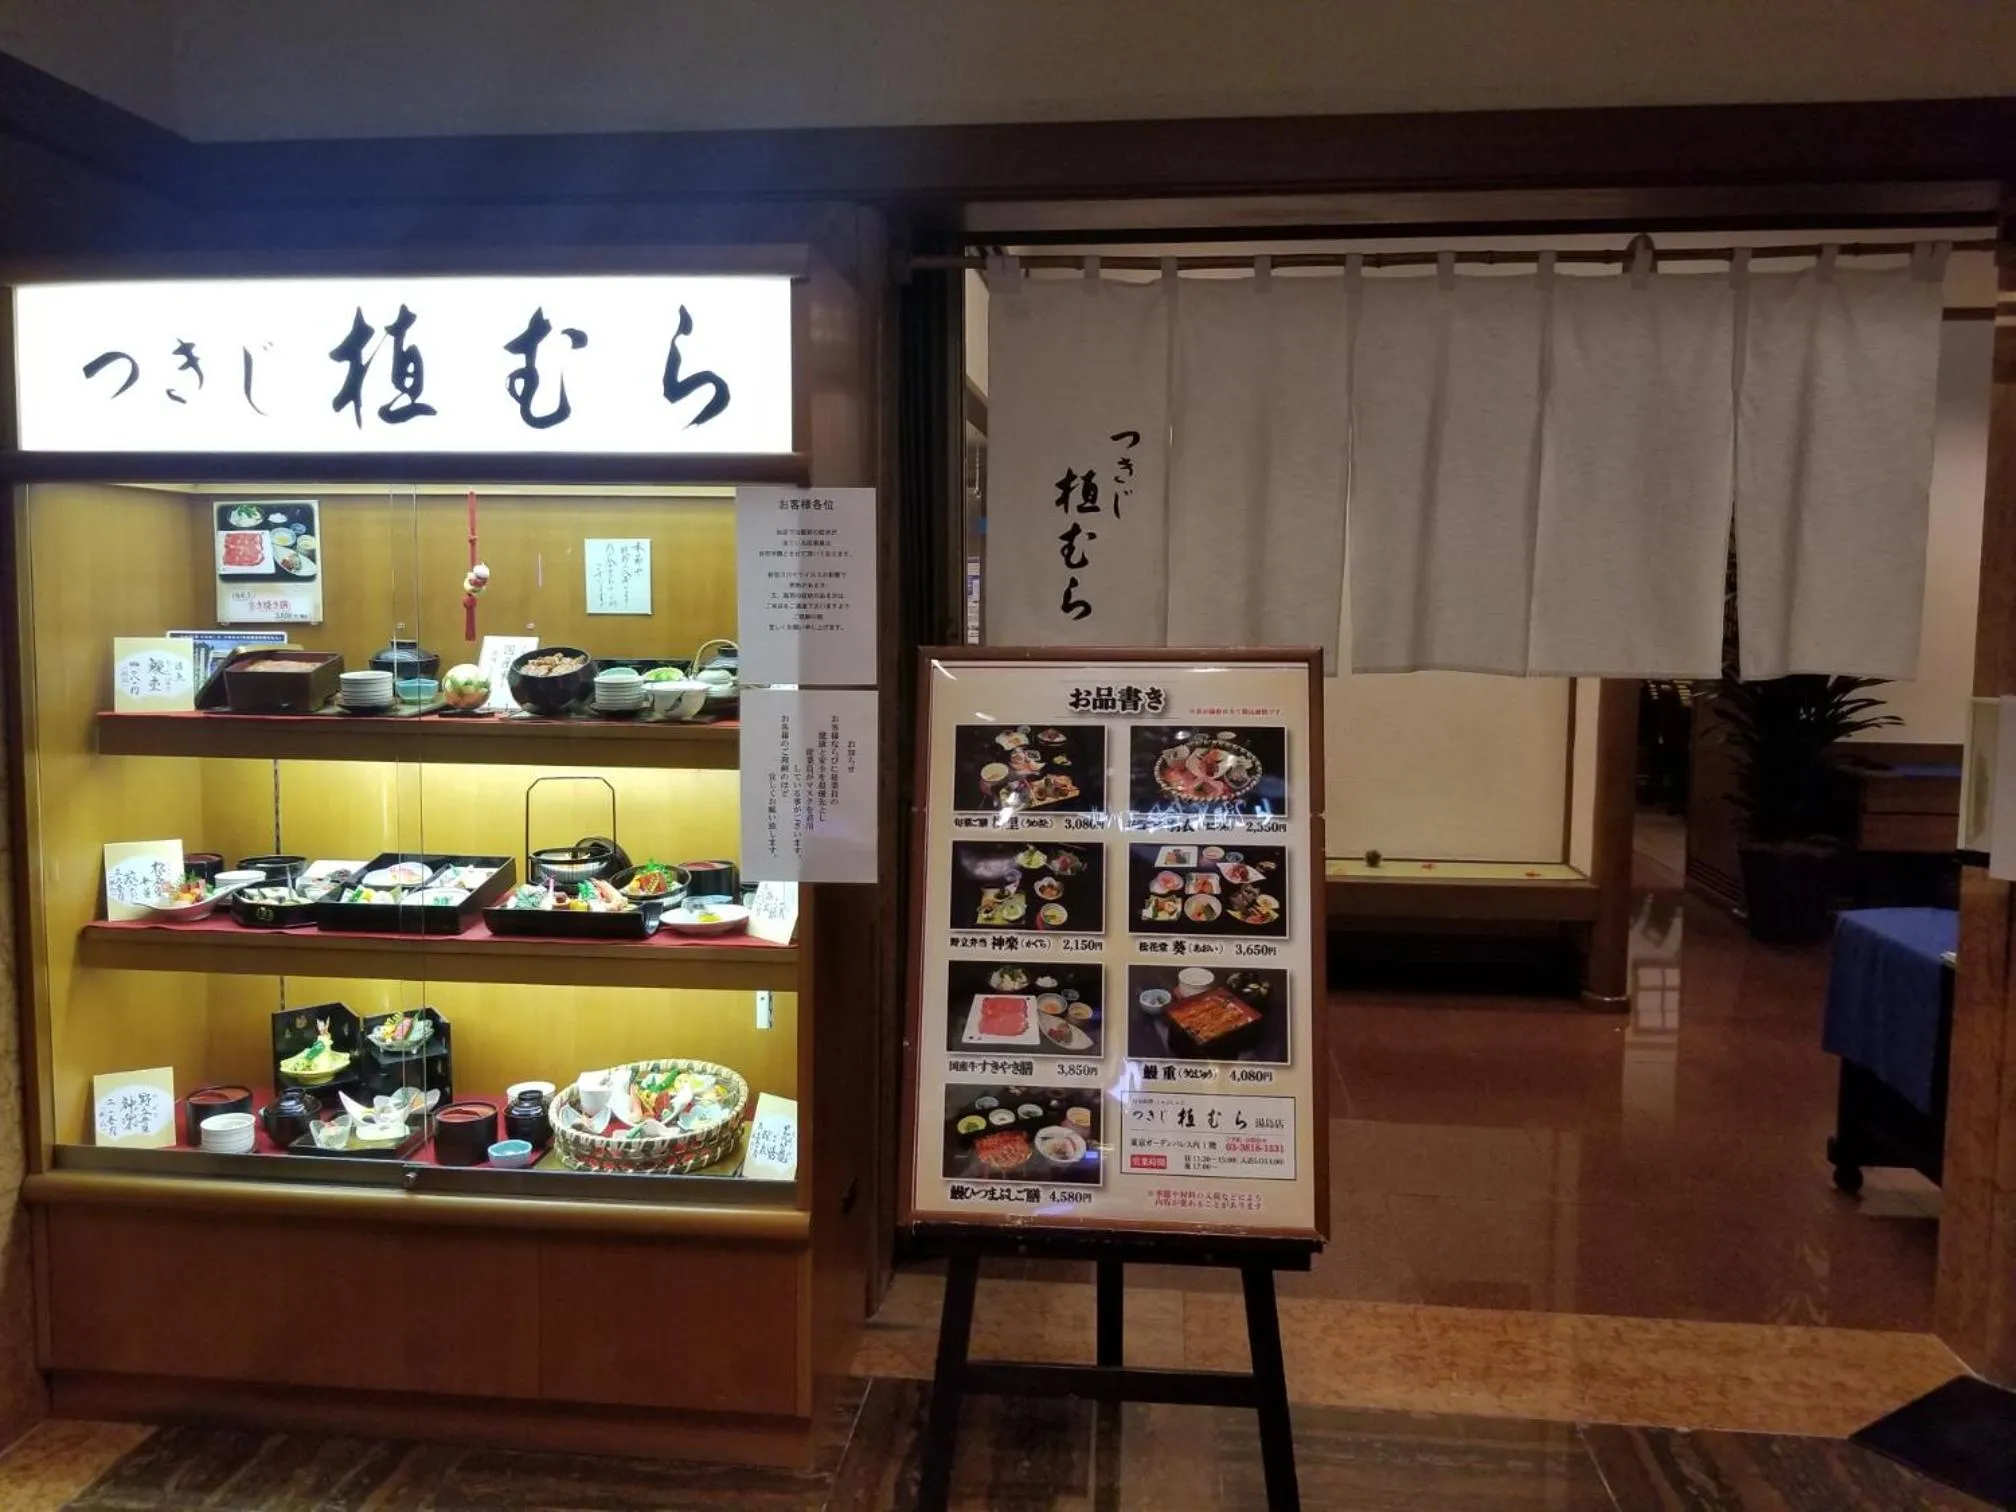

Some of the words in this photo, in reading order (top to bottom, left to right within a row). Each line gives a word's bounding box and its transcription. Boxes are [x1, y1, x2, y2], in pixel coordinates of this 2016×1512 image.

[82, 338, 274, 417] つきじ
[329, 303, 732, 430] 植むら
[1110, 431, 1141, 519] つきじ
[779, 499, 834, 510] お客様各位
[1055, 467, 1101, 621] 植むら
[1067, 686, 1165, 712] お品書き
[992, 816, 1019, 830] 里
[992, 936, 1019, 950] 神楽
[1062, 939, 1103, 951] 2,150円
[1235, 943, 1277, 956] 3,650円
[1057, 1063, 1098, 1076] 3,850円
[1229, 1070, 1273, 1083] 4,080円
[1133, 1109, 1169, 1124] つきじ
[1177, 1108, 1248, 1130] 植むら
[1049, 1190, 1092, 1204] 4,580円
